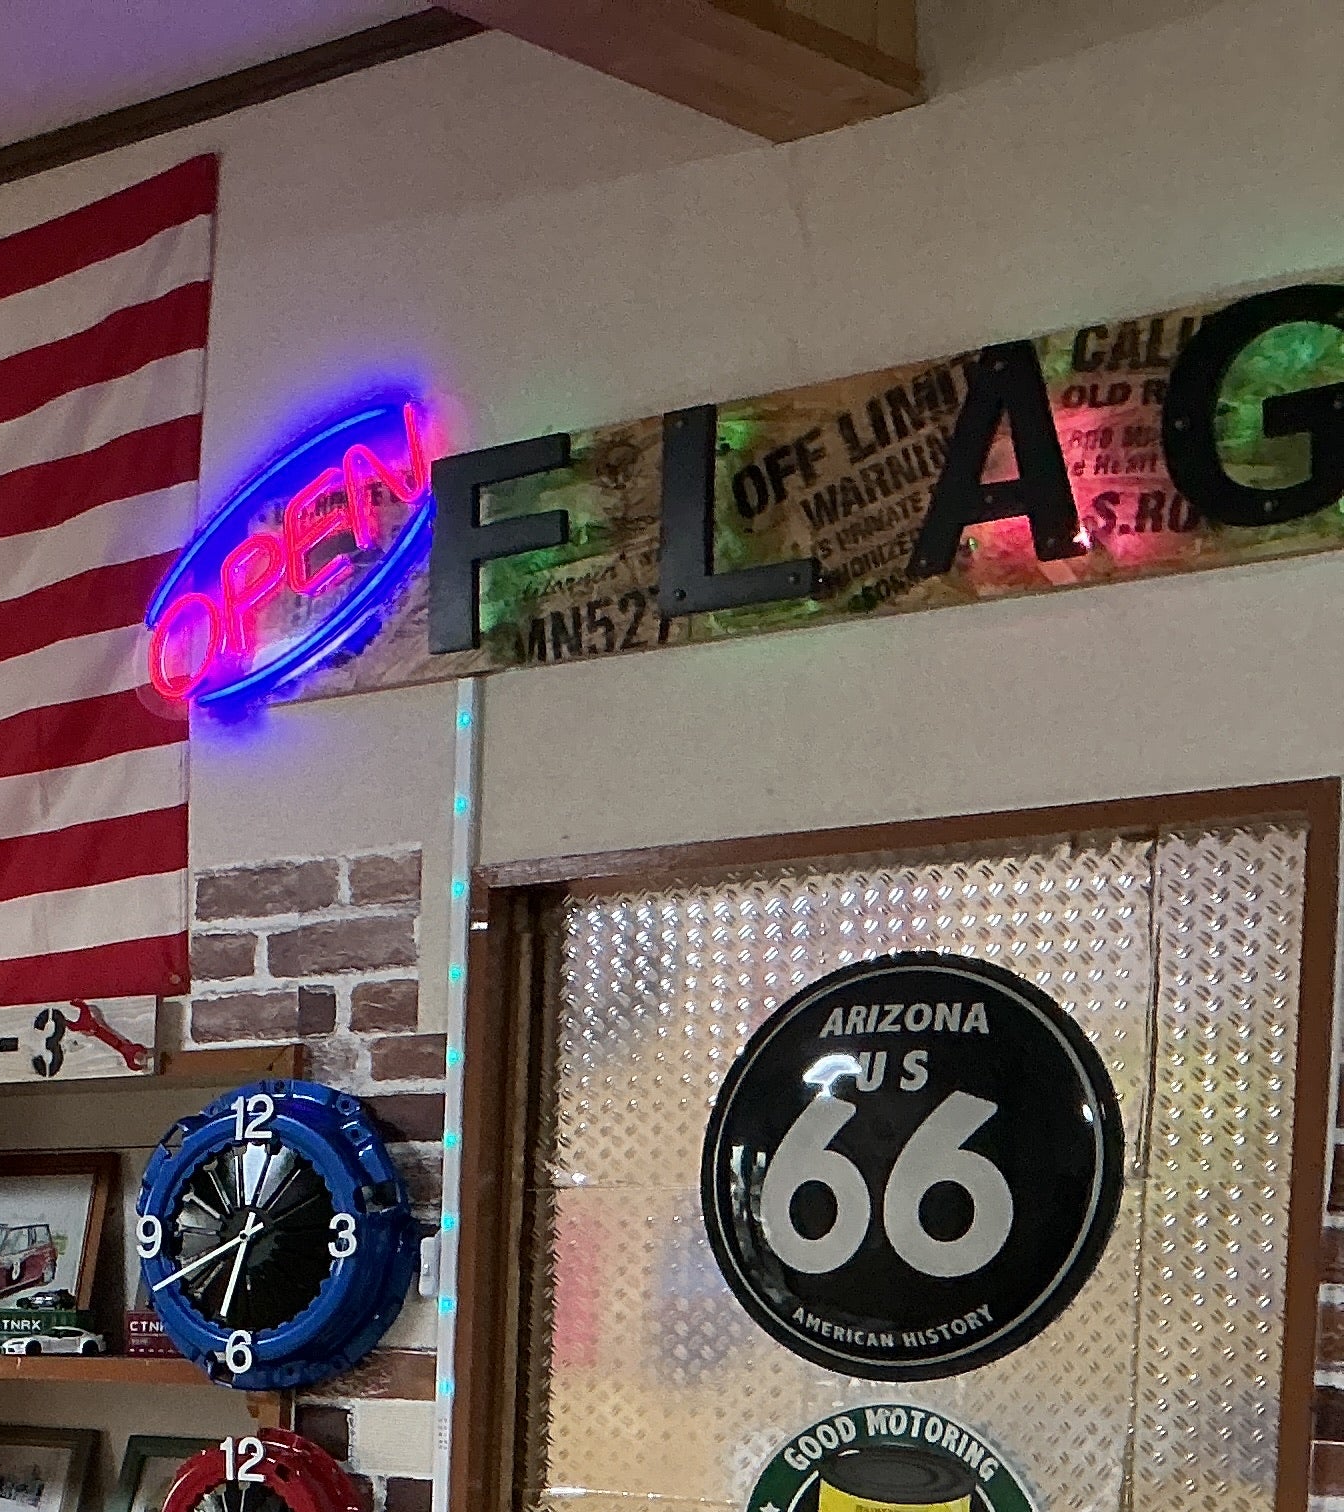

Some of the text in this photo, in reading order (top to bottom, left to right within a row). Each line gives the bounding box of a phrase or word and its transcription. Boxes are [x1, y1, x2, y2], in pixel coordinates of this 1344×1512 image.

[148, 402, 428, 699] OPEN
[818, 1002, 990, 1039] ARIZONA
[230, 1093, 274, 1141] 12
[760, 1089, 1015, 1278] 66
[136, 1214, 163, 1258] 9
[328, 1212, 357, 1258] 3
[792, 1303, 995, 1349] AMERICAN HISTORY
[225, 1329, 252, 1374] 6
[219, 1436, 265, 1483] 12
[783, 1407, 1000, 1483] GOOD MOTORING
